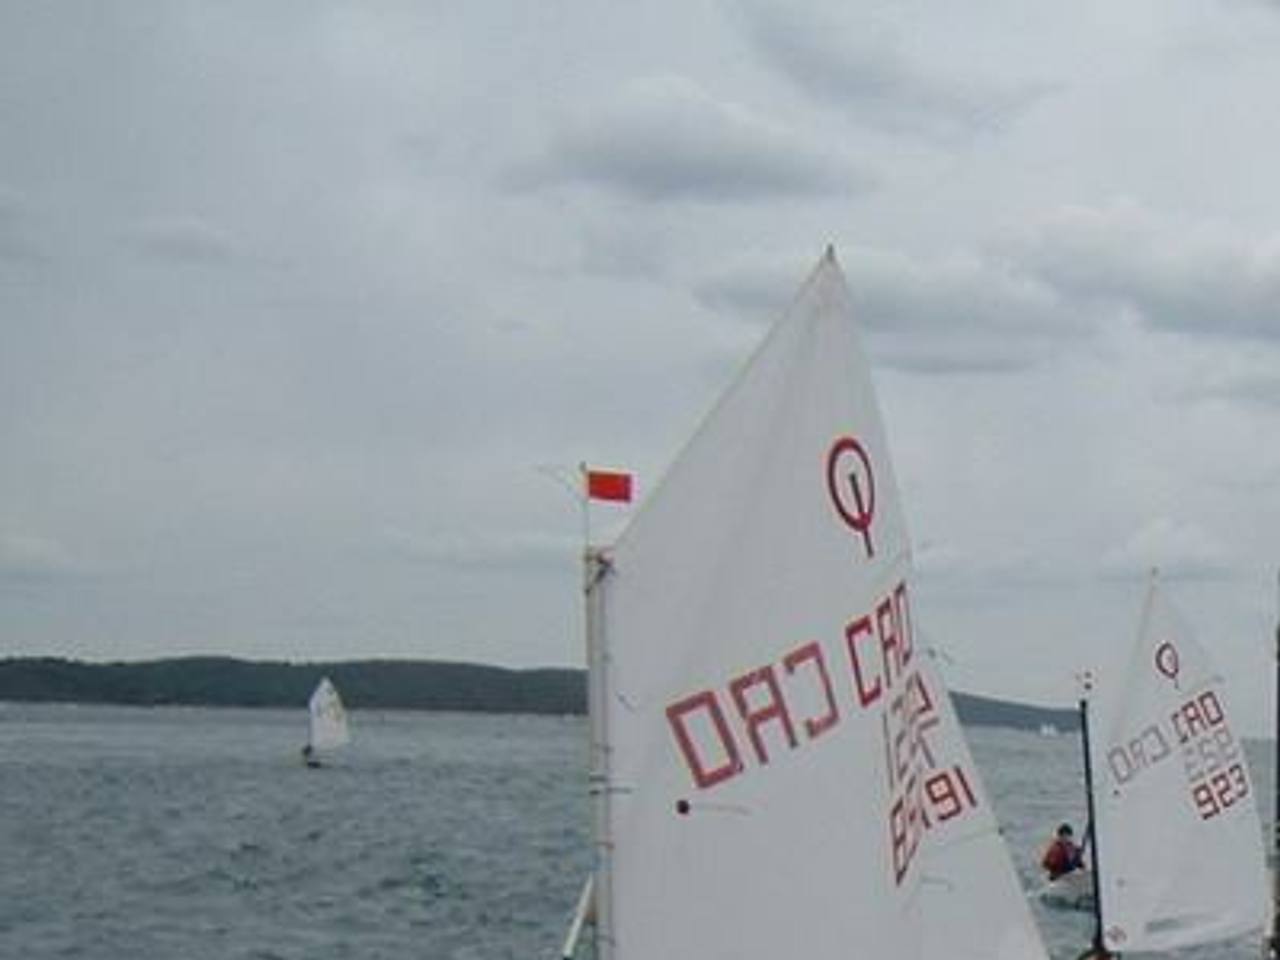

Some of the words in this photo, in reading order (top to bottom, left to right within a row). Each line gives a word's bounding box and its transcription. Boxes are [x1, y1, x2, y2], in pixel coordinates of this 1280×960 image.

[845, 580, 913, 706] CRO
[1171, 691, 1224, 744] CRO
[1193, 764, 1248, 820] 923
